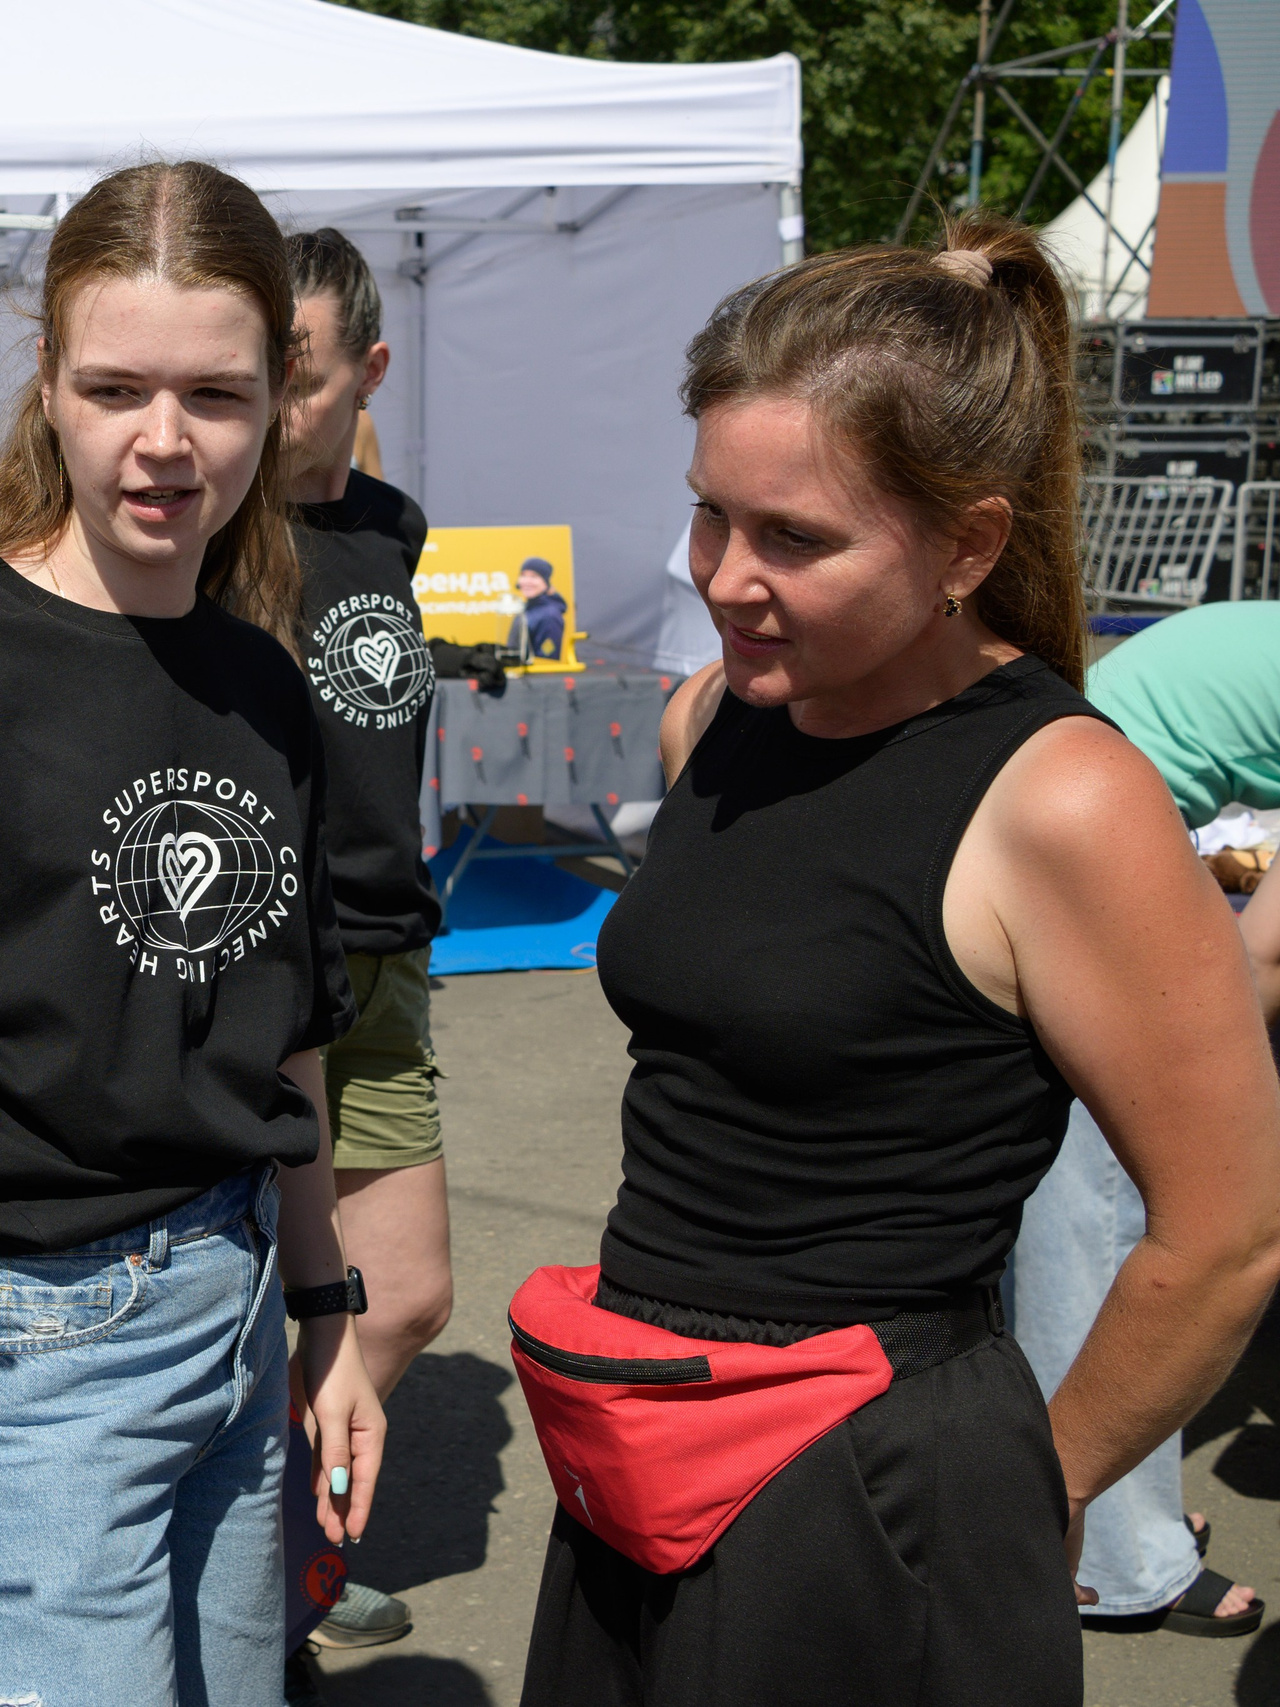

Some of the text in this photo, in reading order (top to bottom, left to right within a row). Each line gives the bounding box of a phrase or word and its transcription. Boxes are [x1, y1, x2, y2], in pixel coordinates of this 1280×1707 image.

[410, 571, 510, 600] ренда
[313, 594, 413, 647] SUPERSPORT
[308, 657, 368, 728] HEARTS
[103, 768, 276, 834] SUPERSPORT
[91, 849, 158, 977] HEARTS
